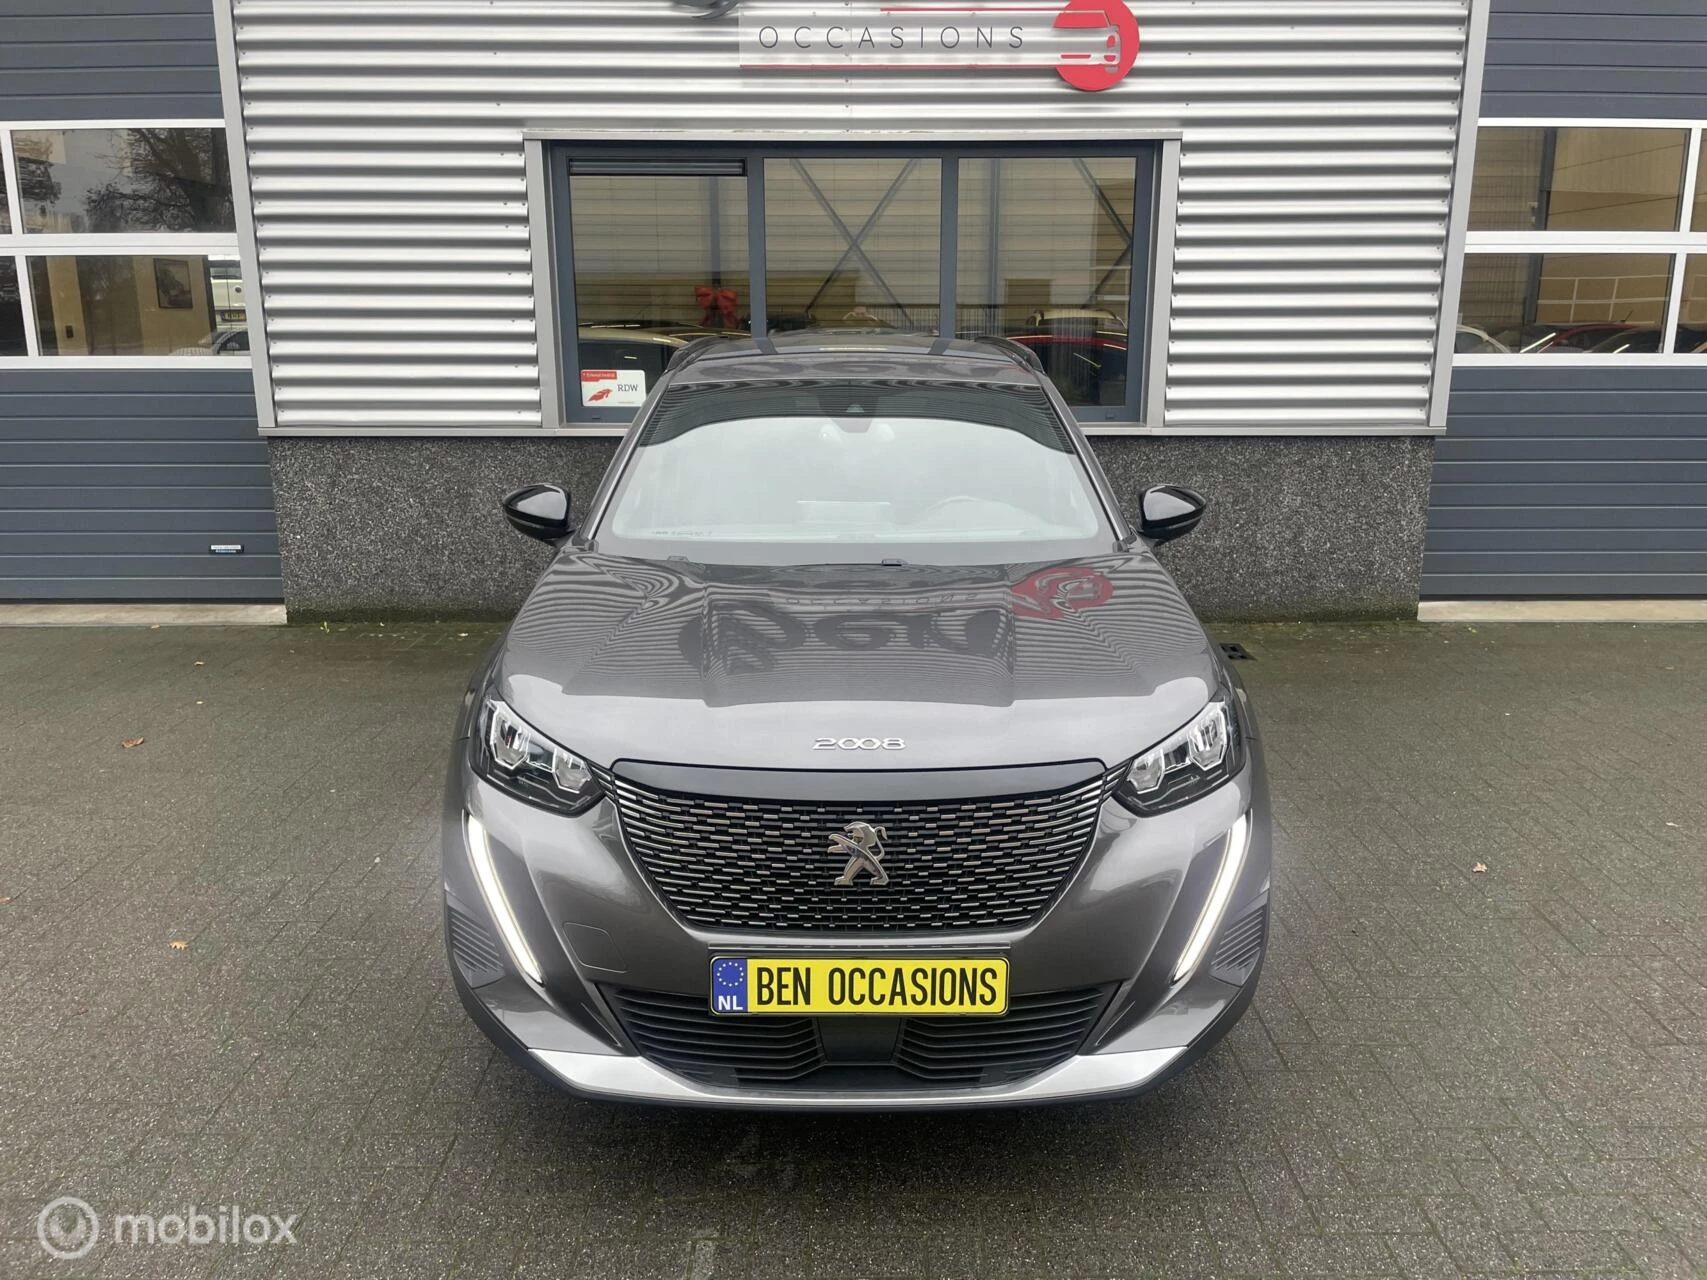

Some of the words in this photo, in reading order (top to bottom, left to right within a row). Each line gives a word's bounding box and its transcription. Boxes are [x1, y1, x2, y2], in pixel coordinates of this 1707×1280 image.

[758, 26, 1024, 49] OCCASIONS
[617, 384, 638, 392] RDW
[812, 737, 906, 750] 2008
[756, 967, 811, 1006] BEN
[828, 967, 998, 1006] OCCASIONS
[718, 995, 743, 1011] NL
